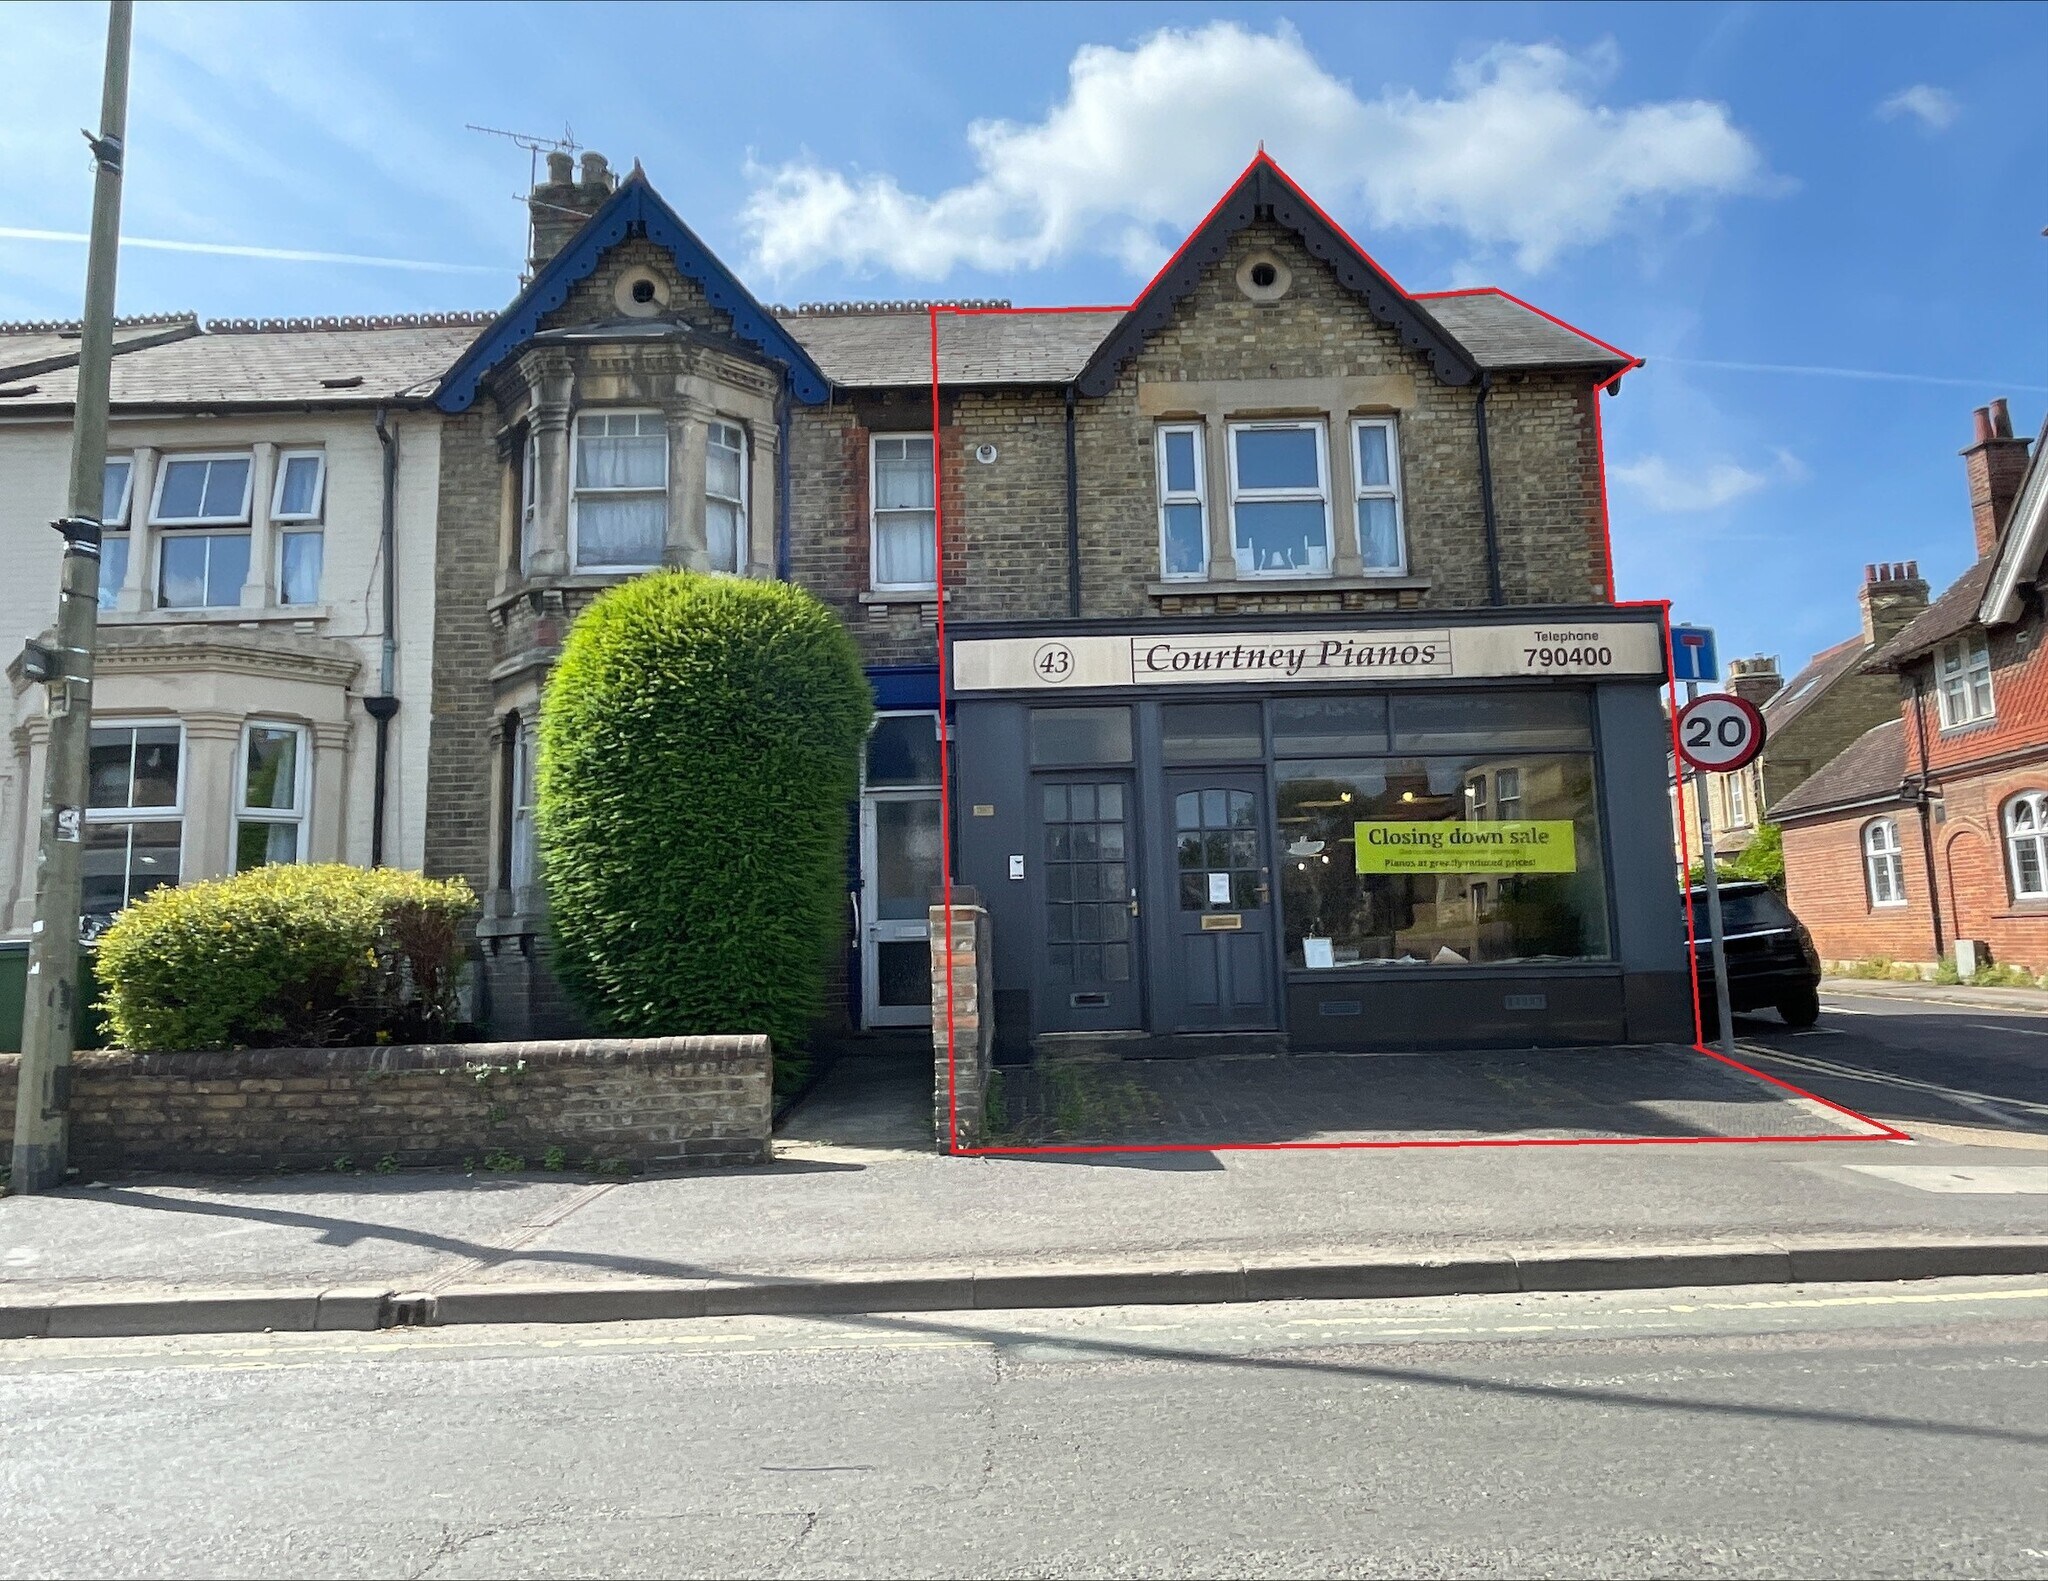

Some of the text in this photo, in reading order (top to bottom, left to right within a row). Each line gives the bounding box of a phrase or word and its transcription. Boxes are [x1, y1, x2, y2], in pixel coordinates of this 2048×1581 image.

[1534, 630, 1599, 642] Telephone
[1040, 651, 1069, 673] 43
[1146, 639, 1437, 676] Courtney Pianos
[1524, 647, 1612, 667] 790400
[1686, 716, 1746, 747] 20
[1369, 828, 1550, 848] Closing down sale
